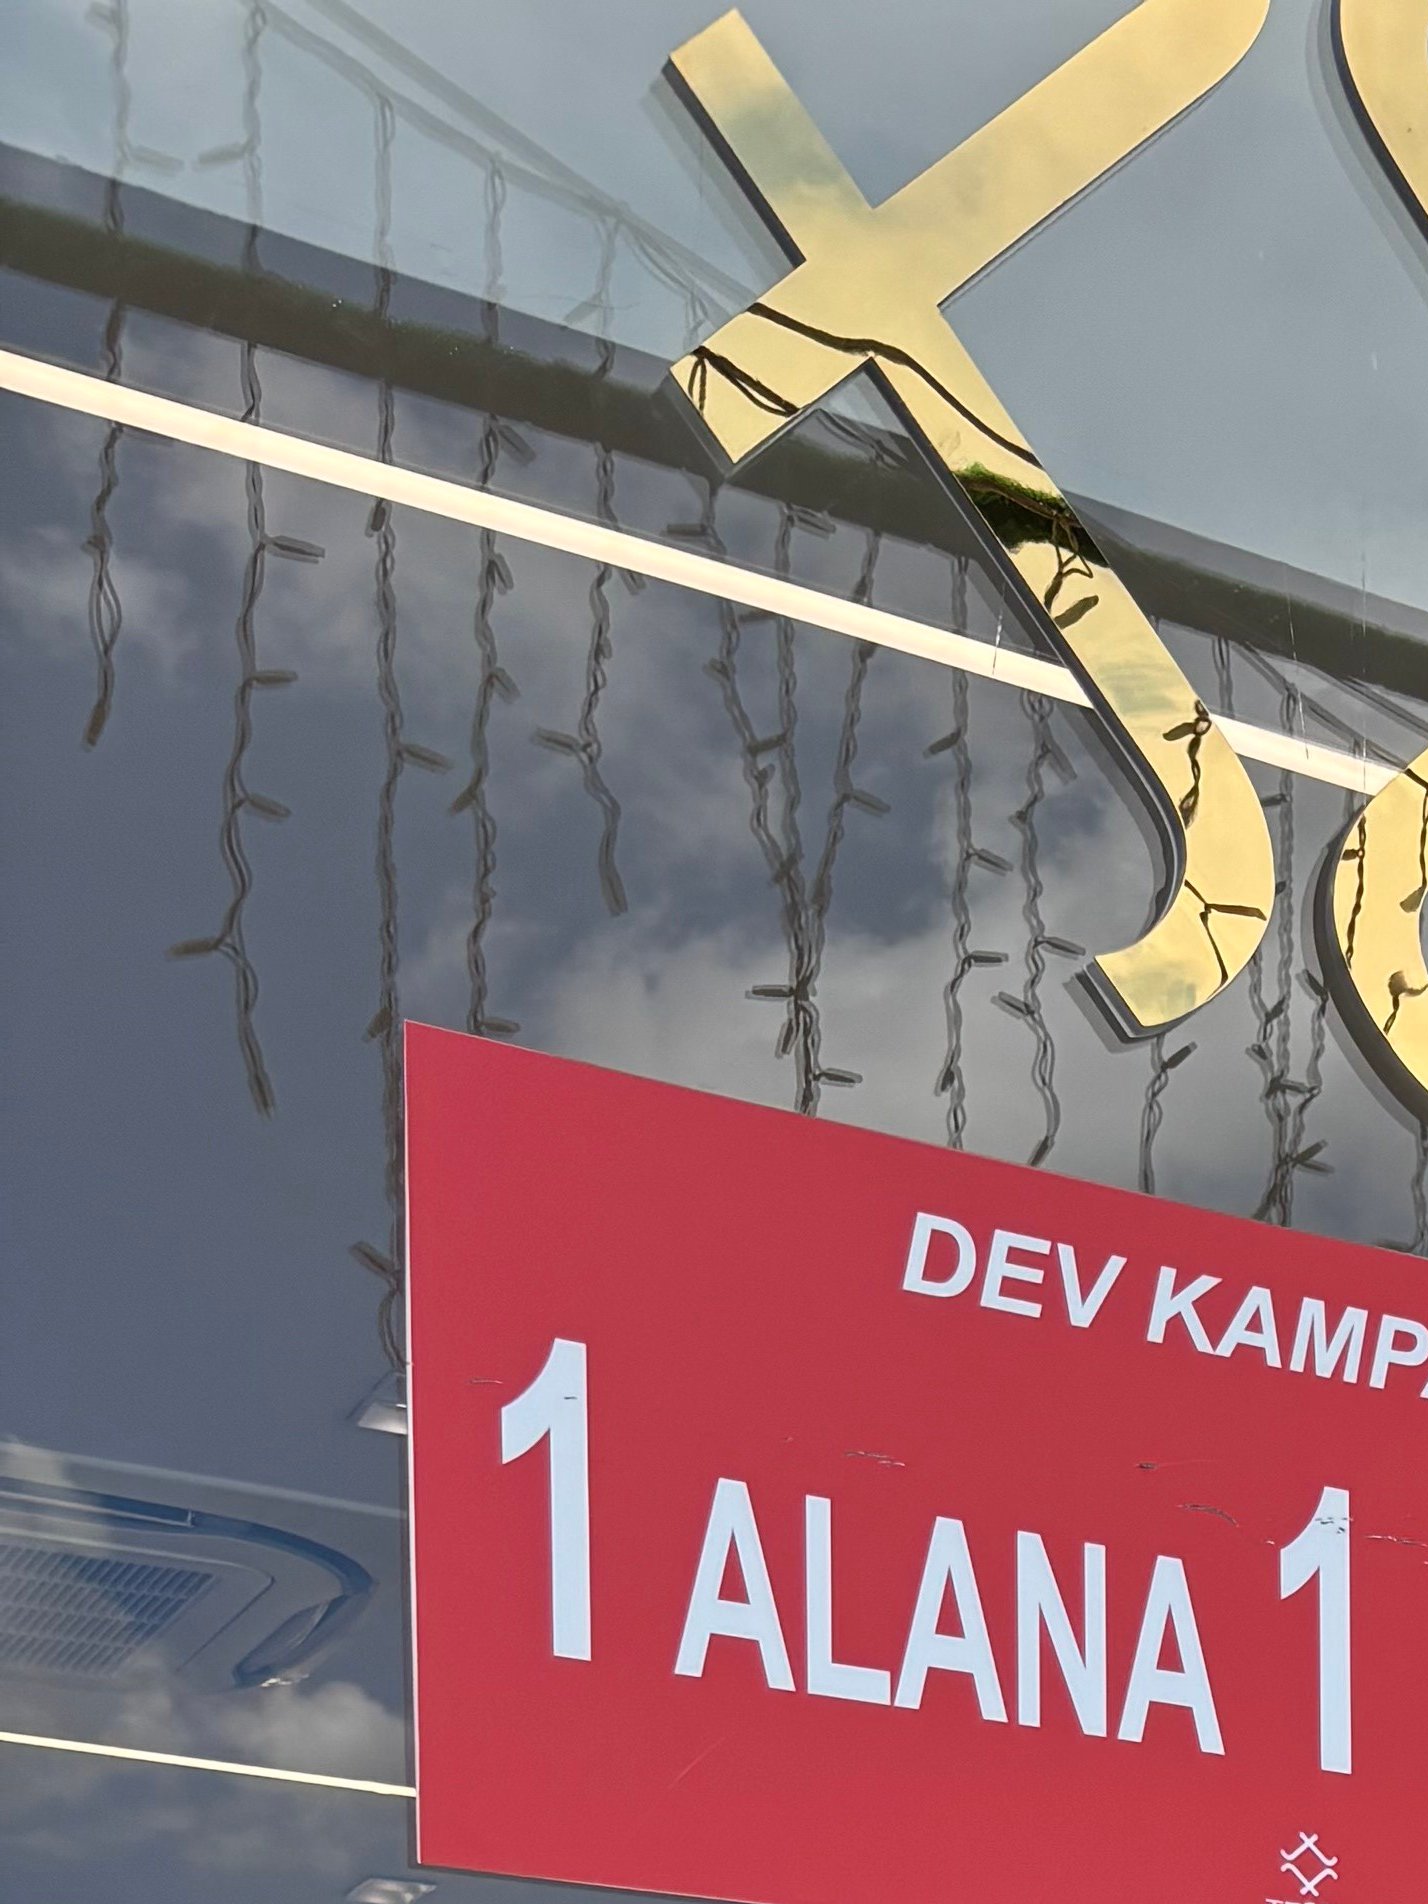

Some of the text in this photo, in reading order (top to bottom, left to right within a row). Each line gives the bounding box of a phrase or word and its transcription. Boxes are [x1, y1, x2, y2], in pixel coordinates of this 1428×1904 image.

[902, 1211, 1128, 1328] DEV
[500, 1337, 592, 1662] 1
[673, 1477, 1226, 1756] ALANA
[1279, 1485, 1352, 1775] 1
